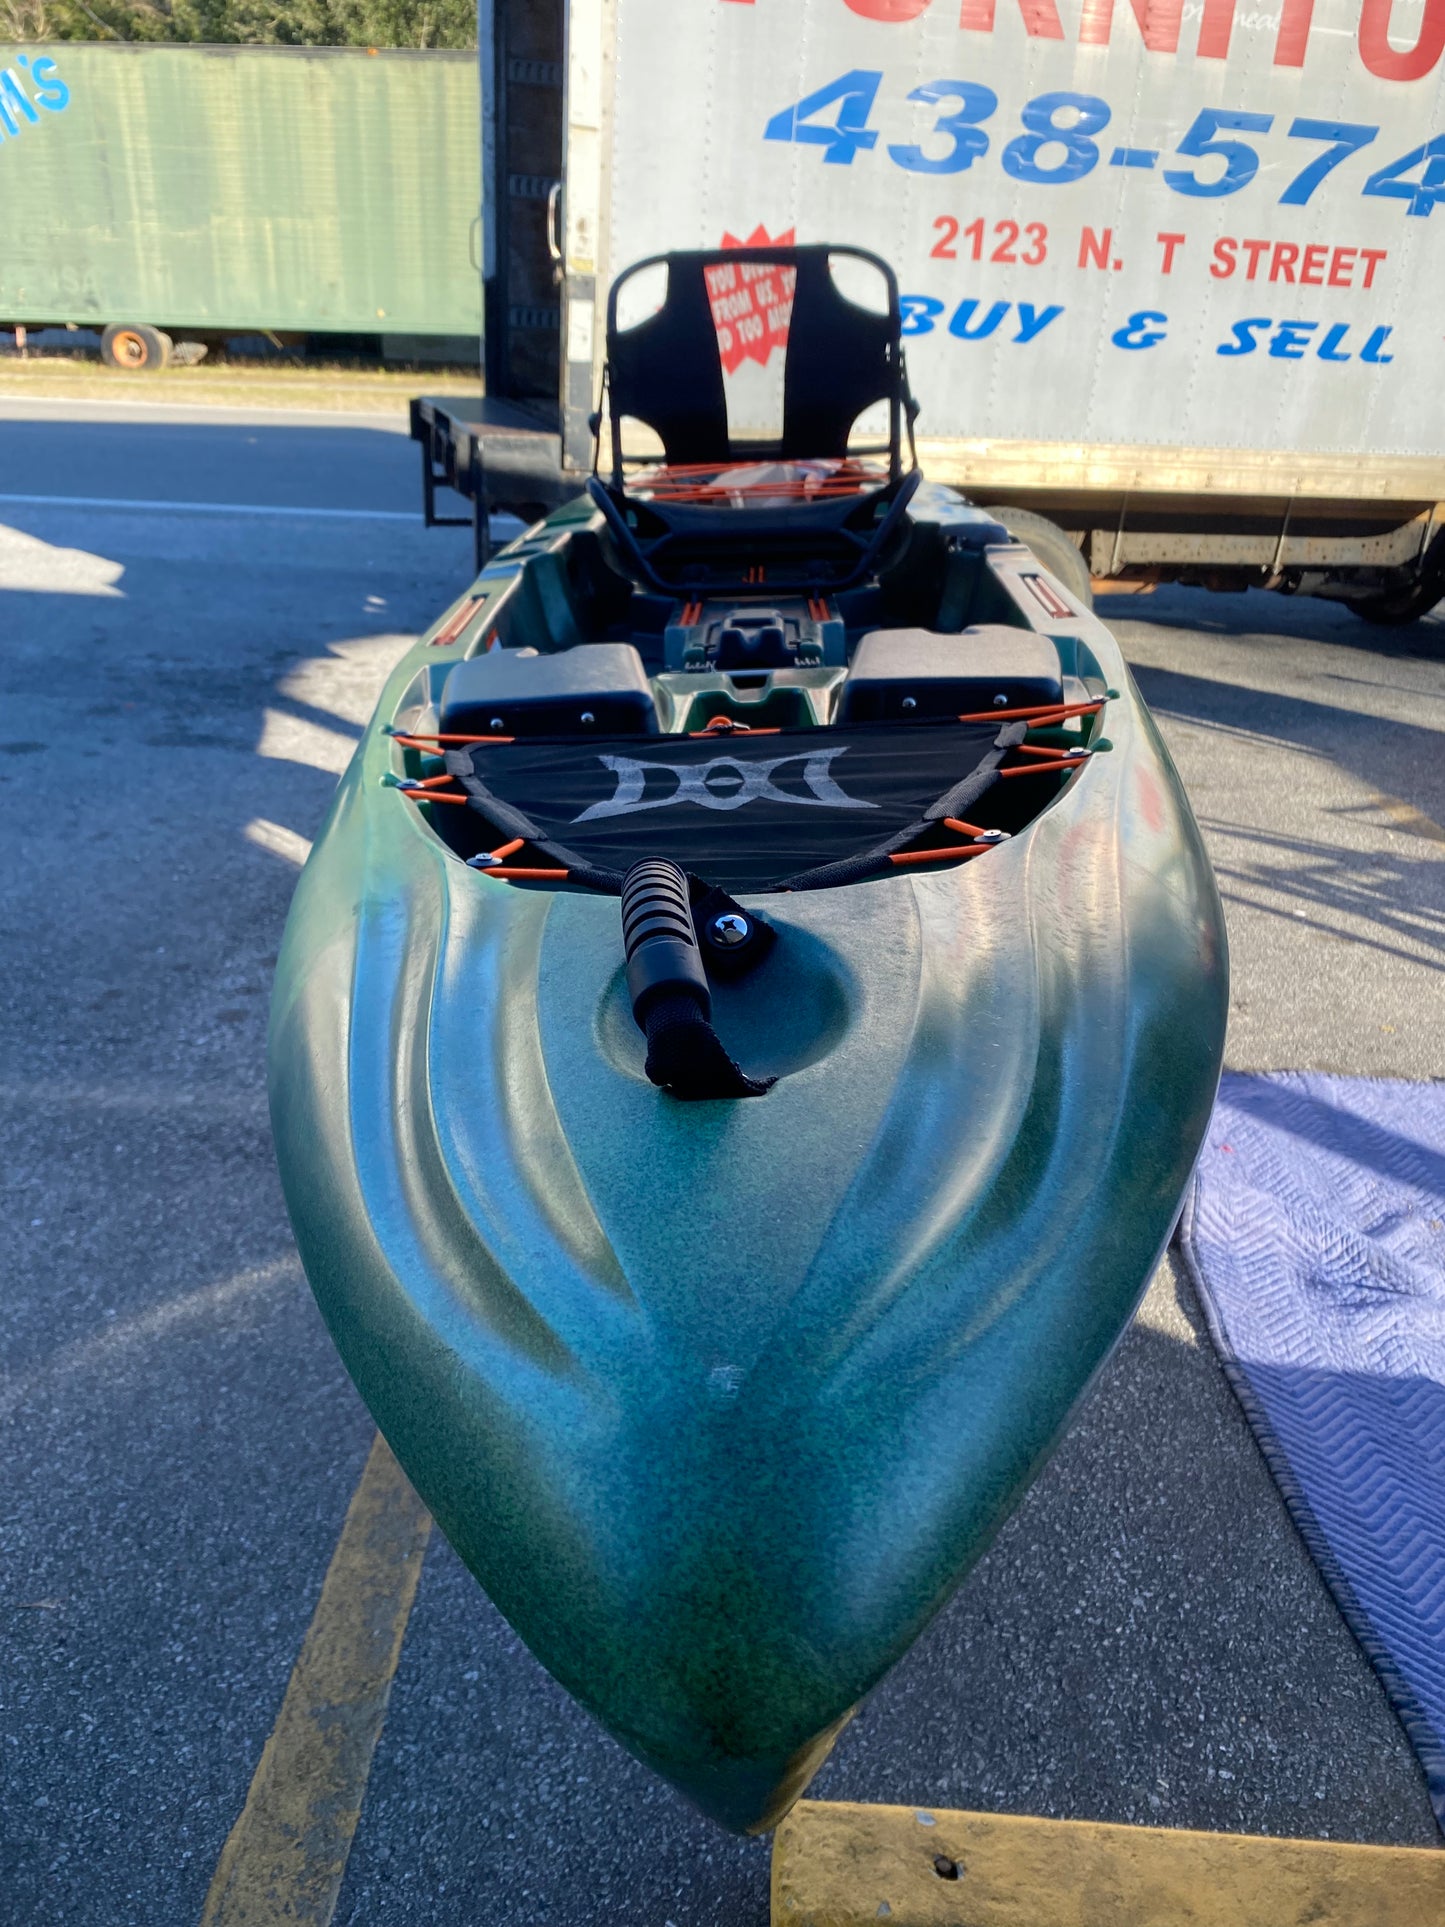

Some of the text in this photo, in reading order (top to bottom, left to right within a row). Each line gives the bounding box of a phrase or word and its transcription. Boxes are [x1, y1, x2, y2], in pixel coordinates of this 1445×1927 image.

[0, 54, 70, 137] M'S
[929, 215, 1387, 289] 2123 N. T STREET
[708, 263, 736, 295] YOU
[712, 289, 753, 324] FROM
[736, 314, 763, 344] TOO
[899, 294, 1395, 364] BUY & SELL
